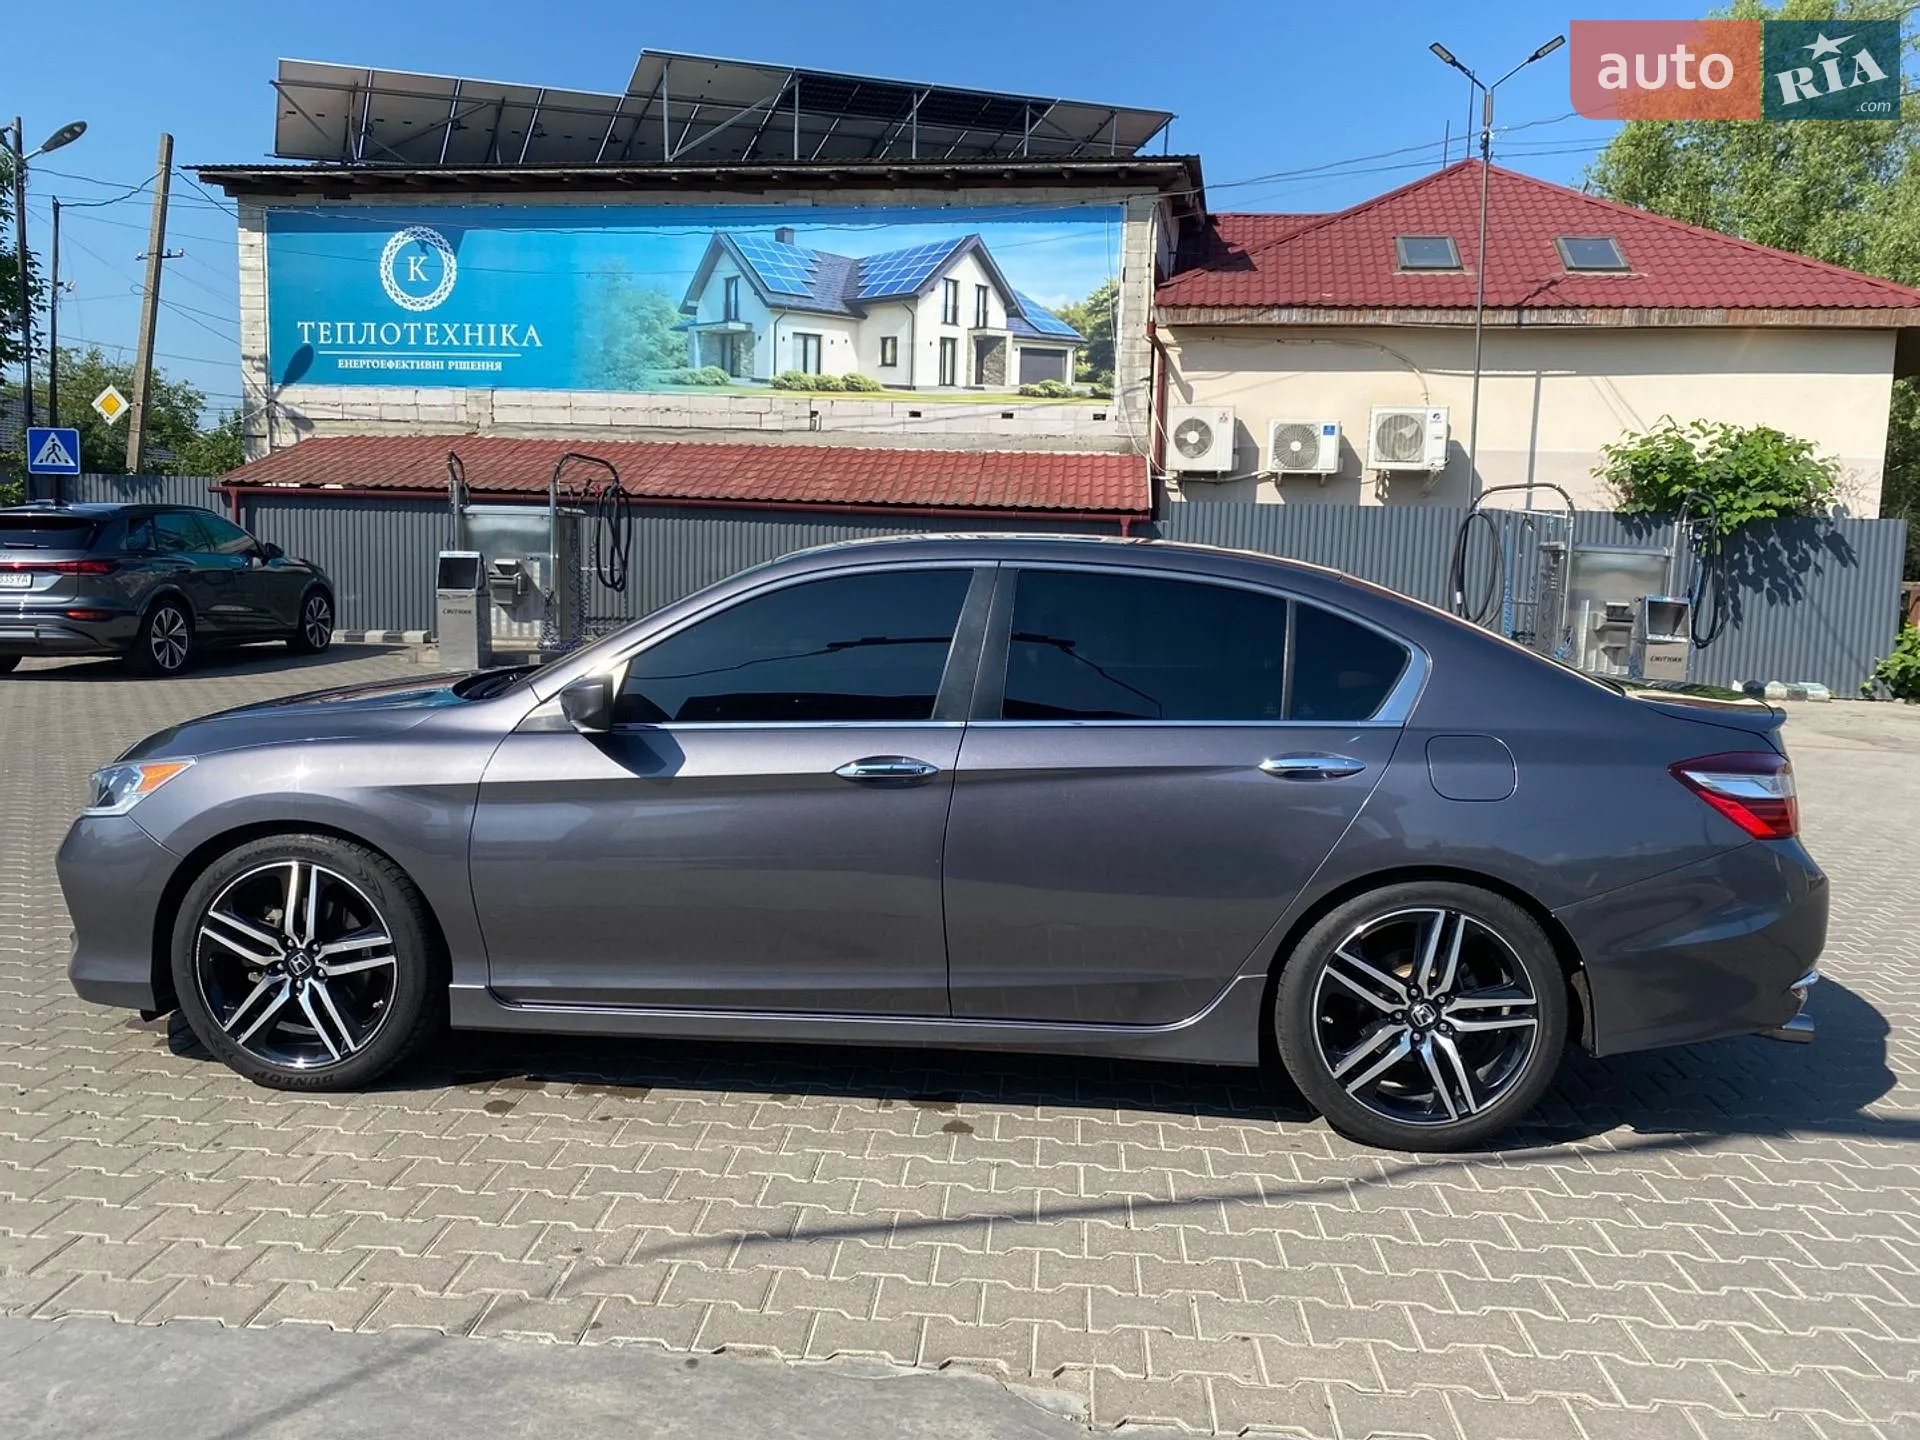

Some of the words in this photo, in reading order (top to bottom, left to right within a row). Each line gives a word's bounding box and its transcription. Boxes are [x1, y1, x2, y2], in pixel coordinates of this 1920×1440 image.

[297, 321, 544, 348] ТЕПЛОТЕХНІКА
[337, 358, 444, 370] ЕНЕРГОЕФЕКТИВНІ
[447, 360, 503, 371] РІШЕННЯ
